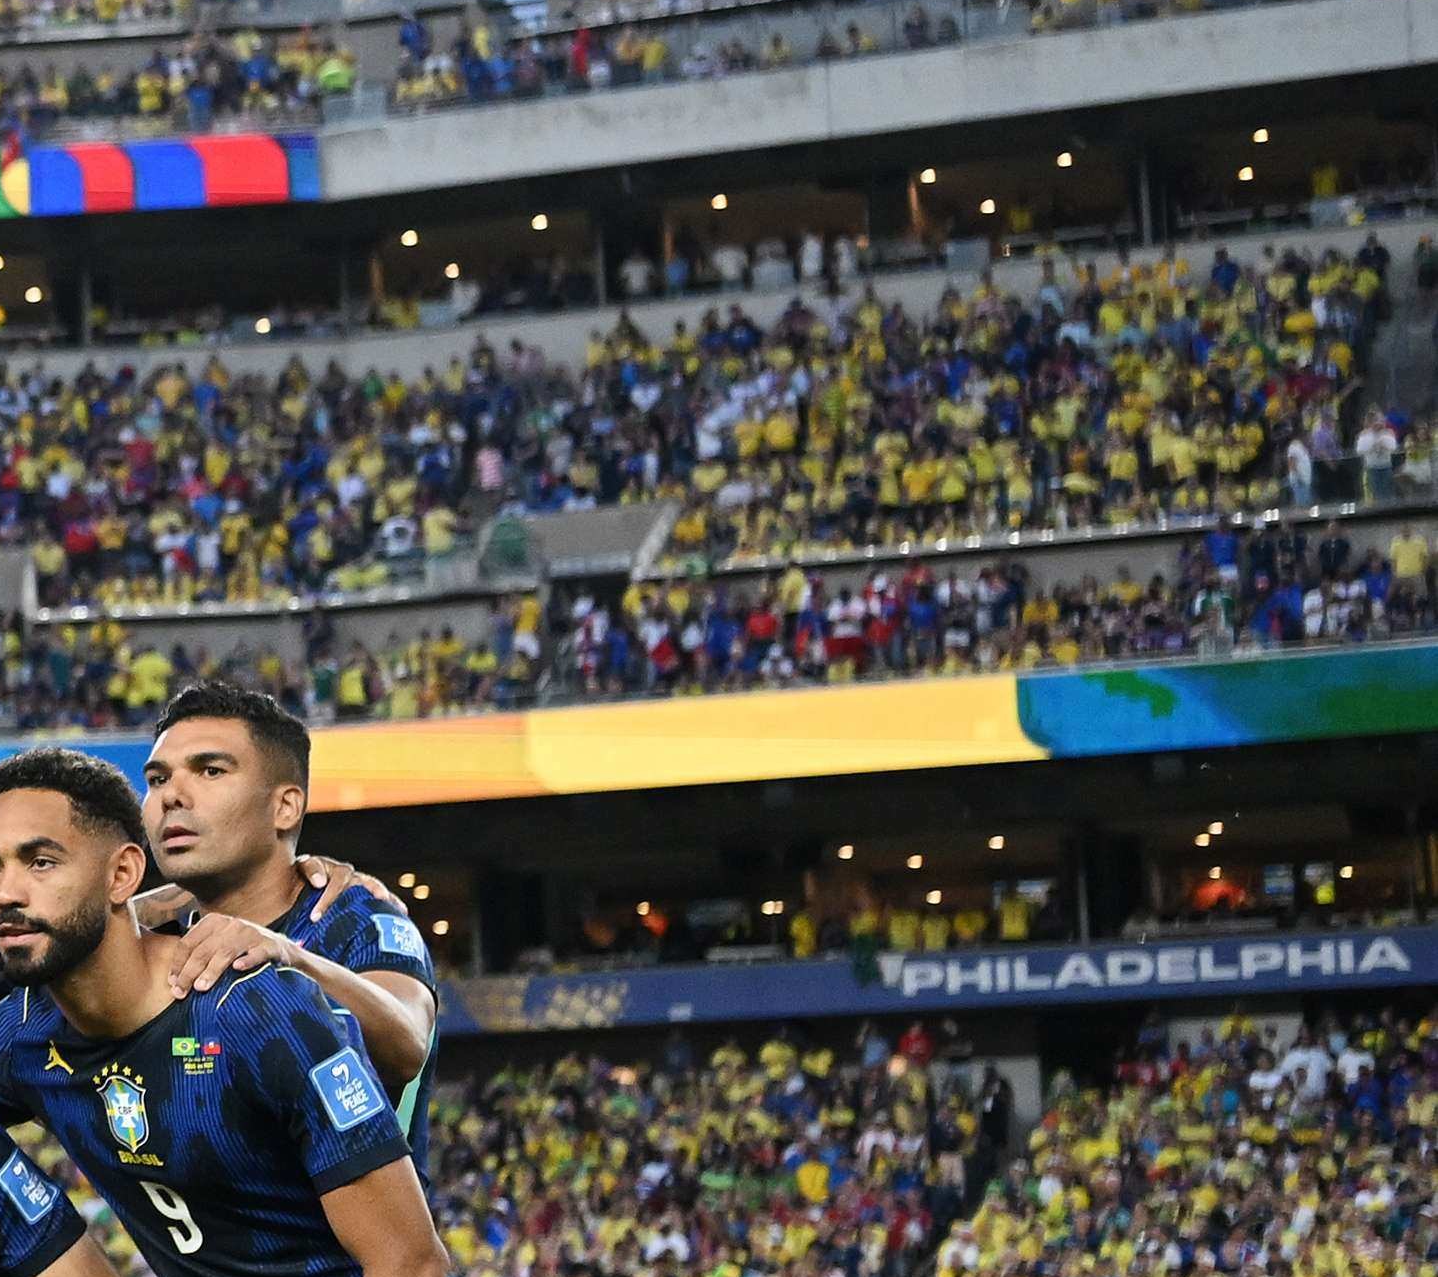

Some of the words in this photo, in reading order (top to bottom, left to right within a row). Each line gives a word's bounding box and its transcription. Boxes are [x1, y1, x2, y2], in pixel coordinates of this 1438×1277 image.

[902, 934, 1411, 997] PHILADELPHIA
[117, 1150, 164, 1167] BRASIL
[139, 1181, 203, 1255] 9
